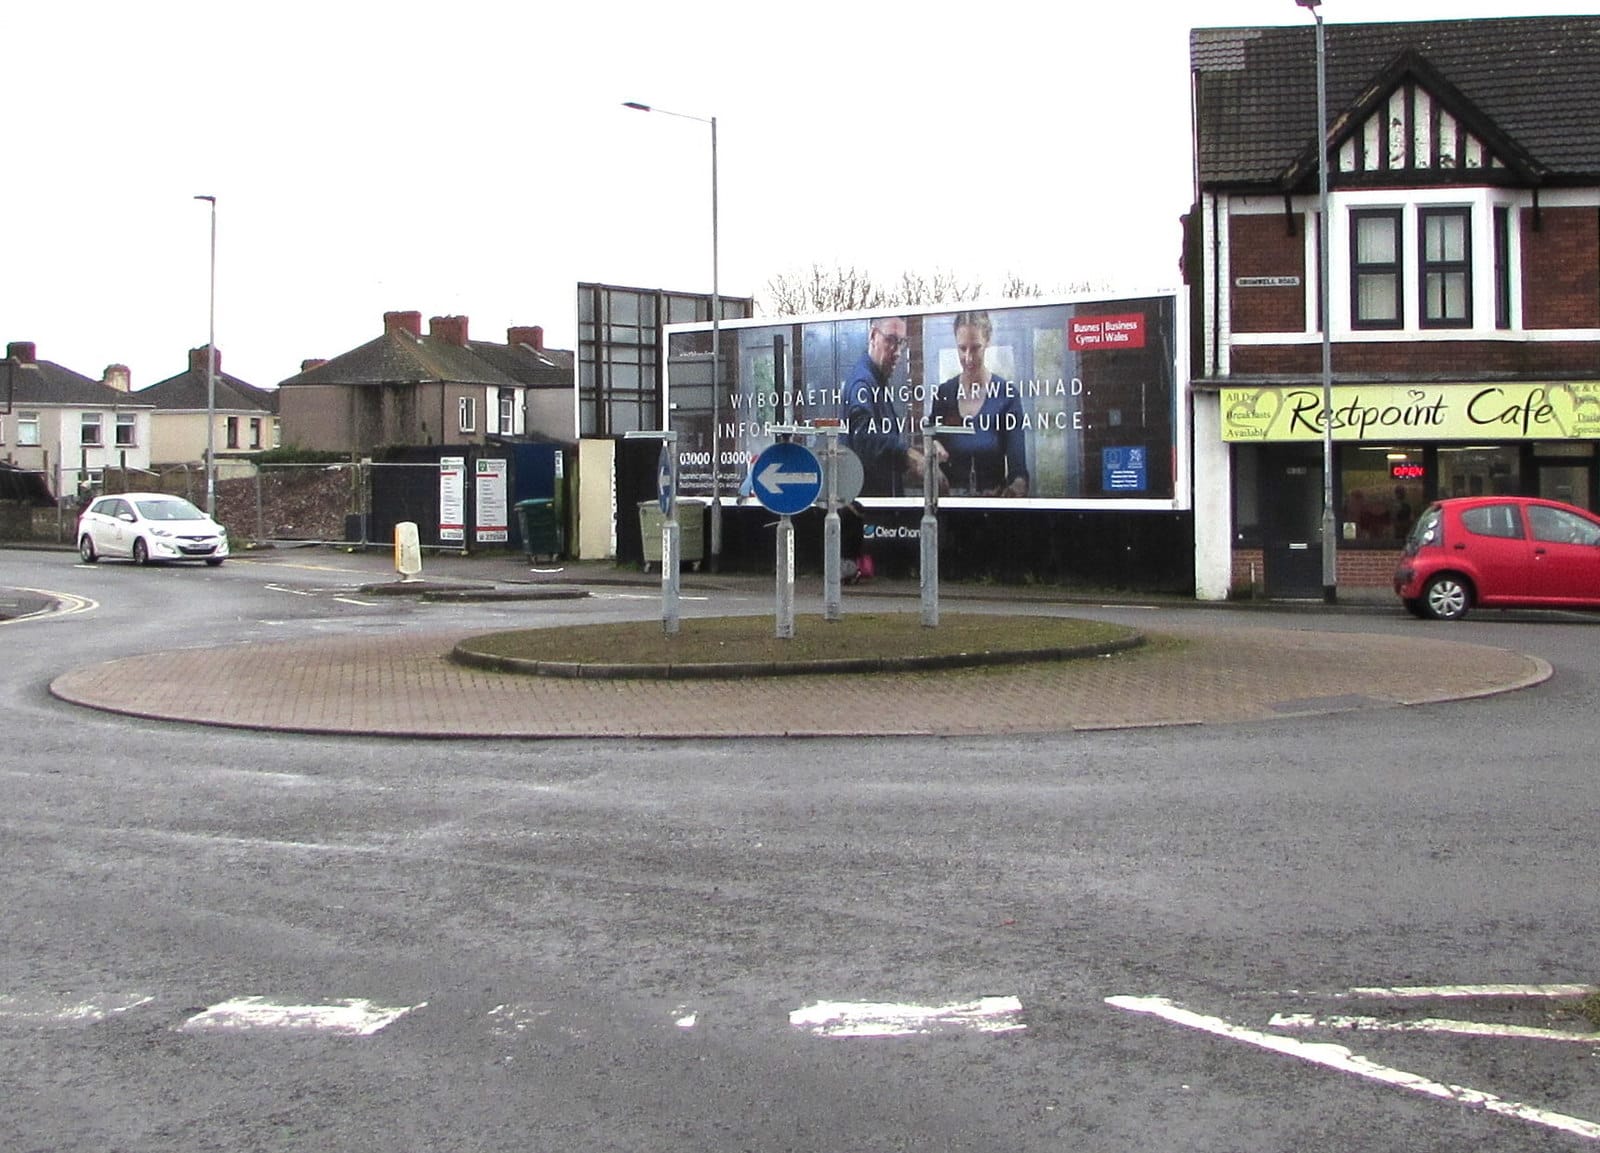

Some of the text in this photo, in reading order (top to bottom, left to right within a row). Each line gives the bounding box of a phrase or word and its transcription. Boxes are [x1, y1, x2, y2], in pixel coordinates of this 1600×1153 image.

[1074, 323, 1100, 333] Busnes
[1104, 320, 1138, 331] Business
[1075, 333, 1101, 346] Cymru
[1104, 332, 1129, 342] Wales
[730, 378, 1091, 409] WYBODAETH. CYNGOR. ARWEINIAD.
[1285, 389, 1449, 439] Restpoint
[962, 411, 1092, 432] GUIDANCE.
[679, 452, 710, 466] 03000
[720, 451, 752, 465] 03000
[1393, 466, 1424, 476] OPEN
[875, 525, 921, 538] Clear Chan
